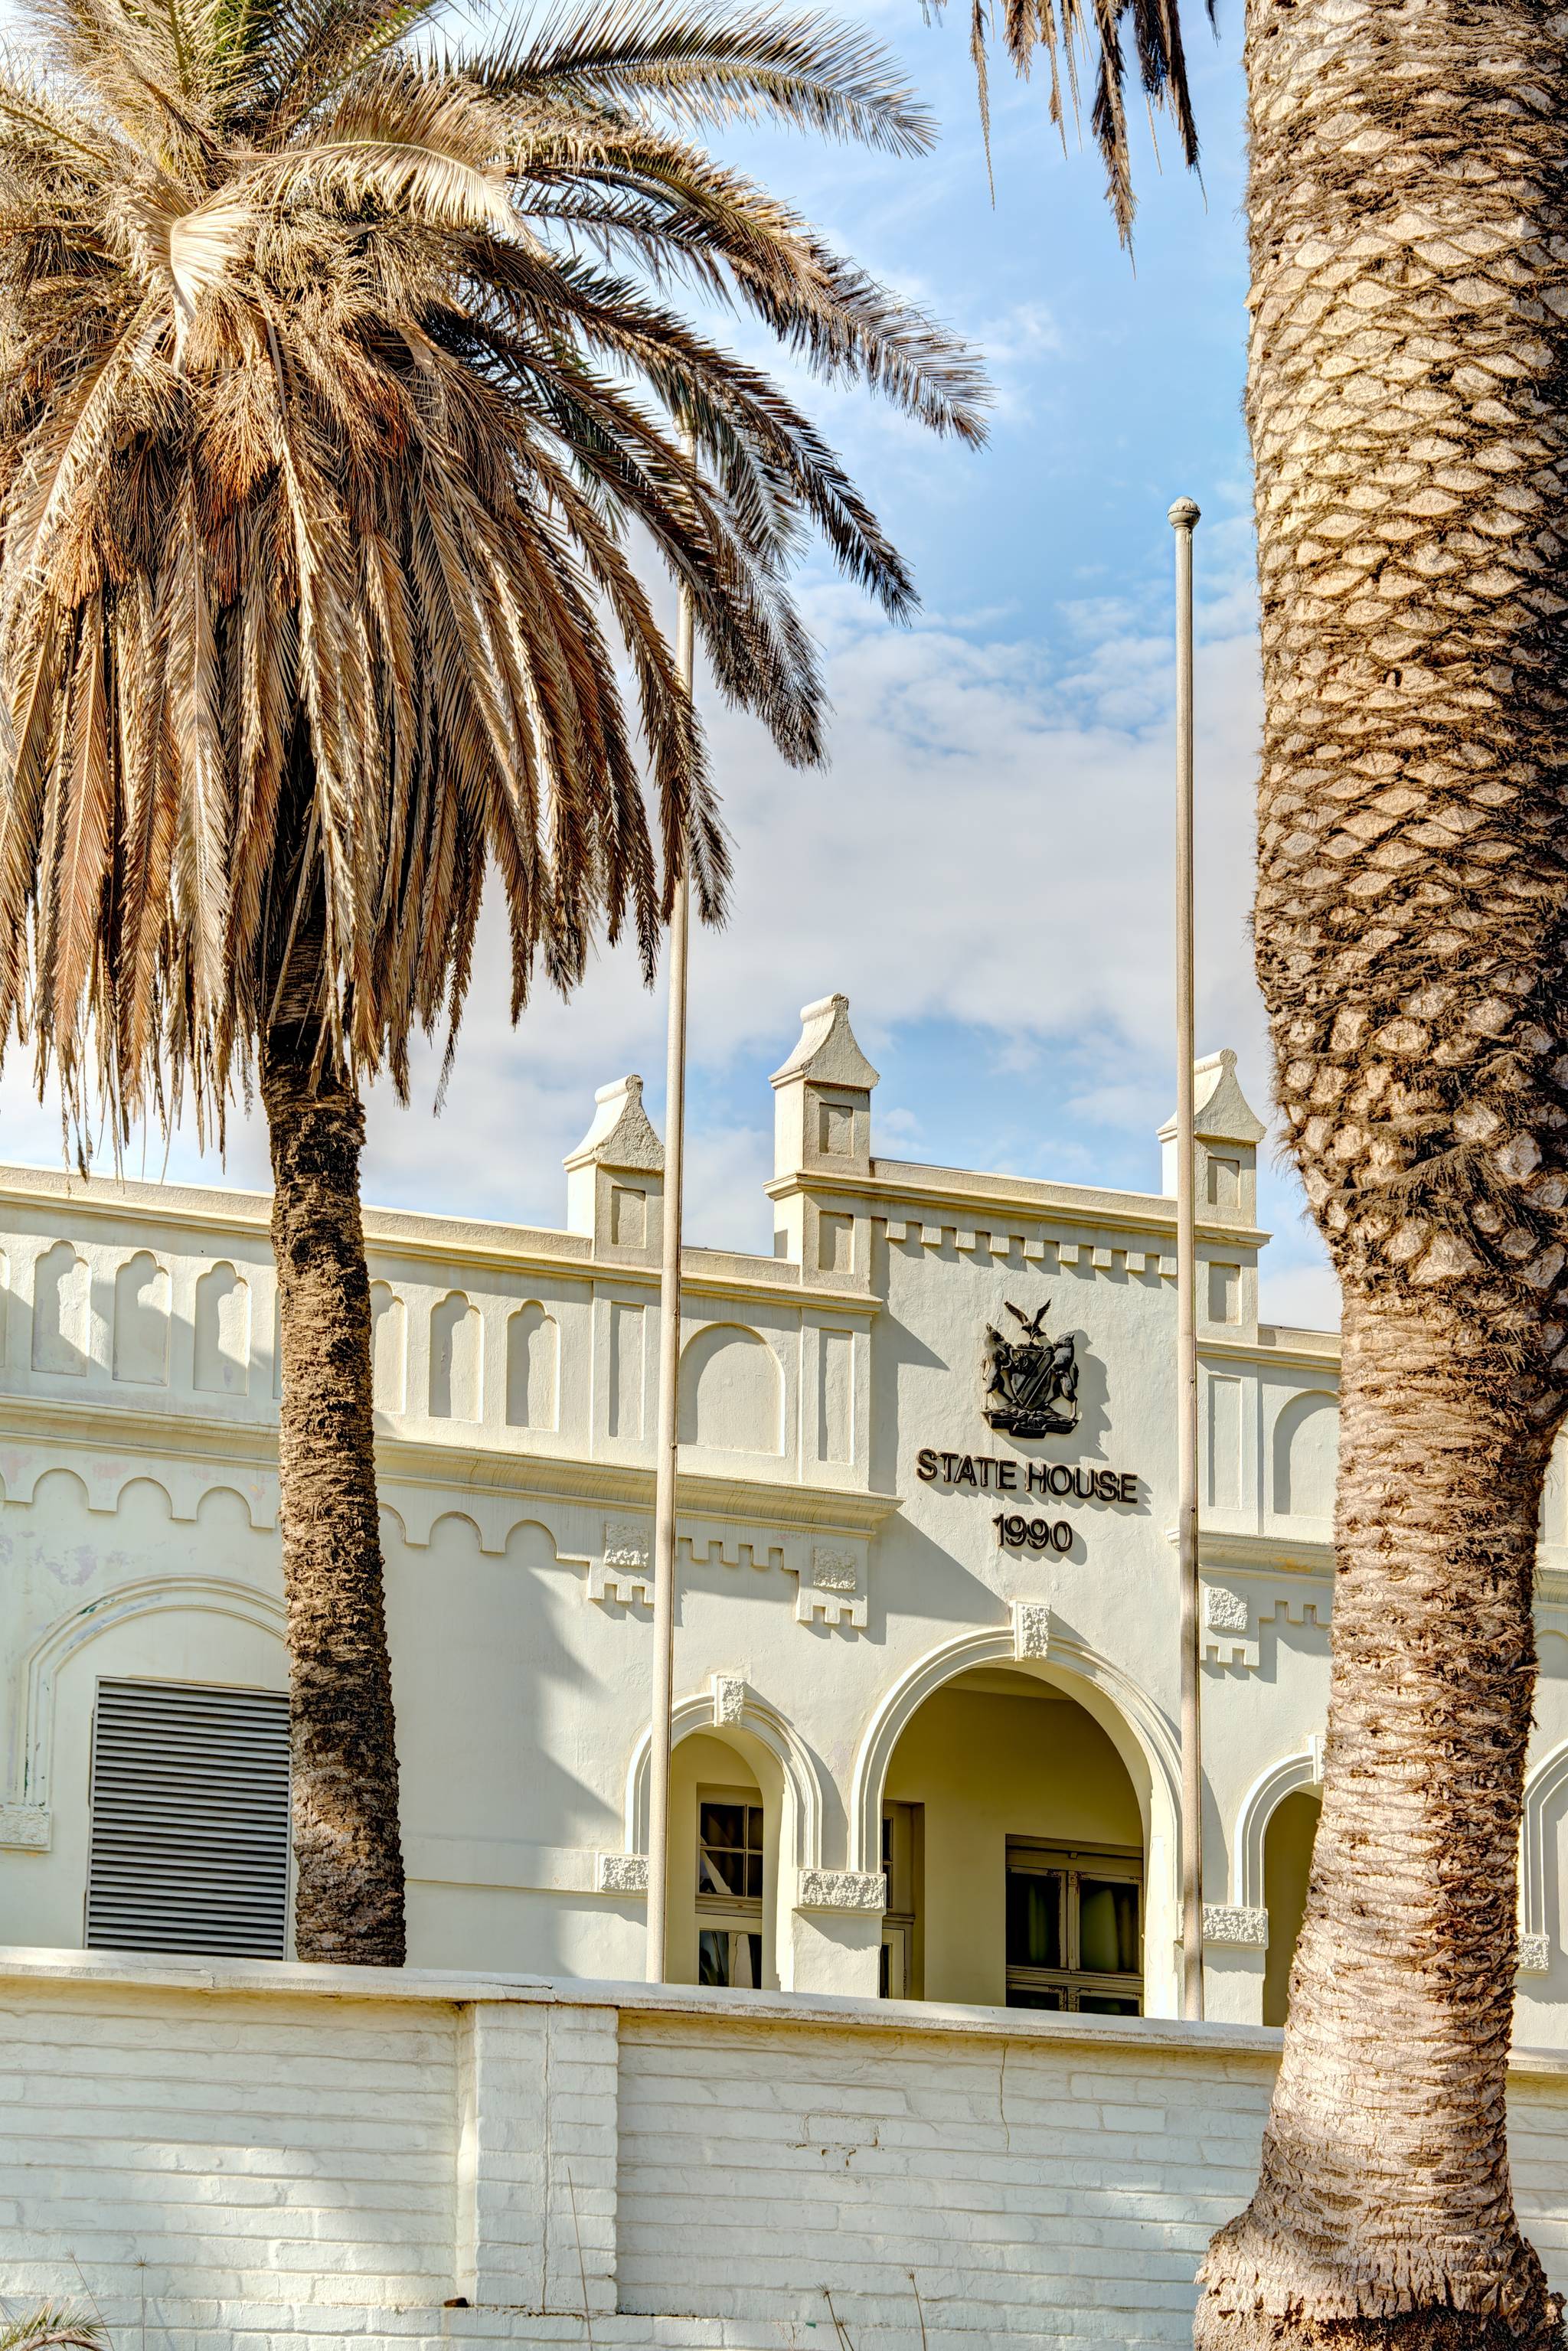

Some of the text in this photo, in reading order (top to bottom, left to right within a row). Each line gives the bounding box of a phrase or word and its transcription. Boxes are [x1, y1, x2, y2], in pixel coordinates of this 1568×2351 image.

[916, 1448, 1138, 1504] STATE HOUSE
[993, 1513, 1073, 1552] 1990
